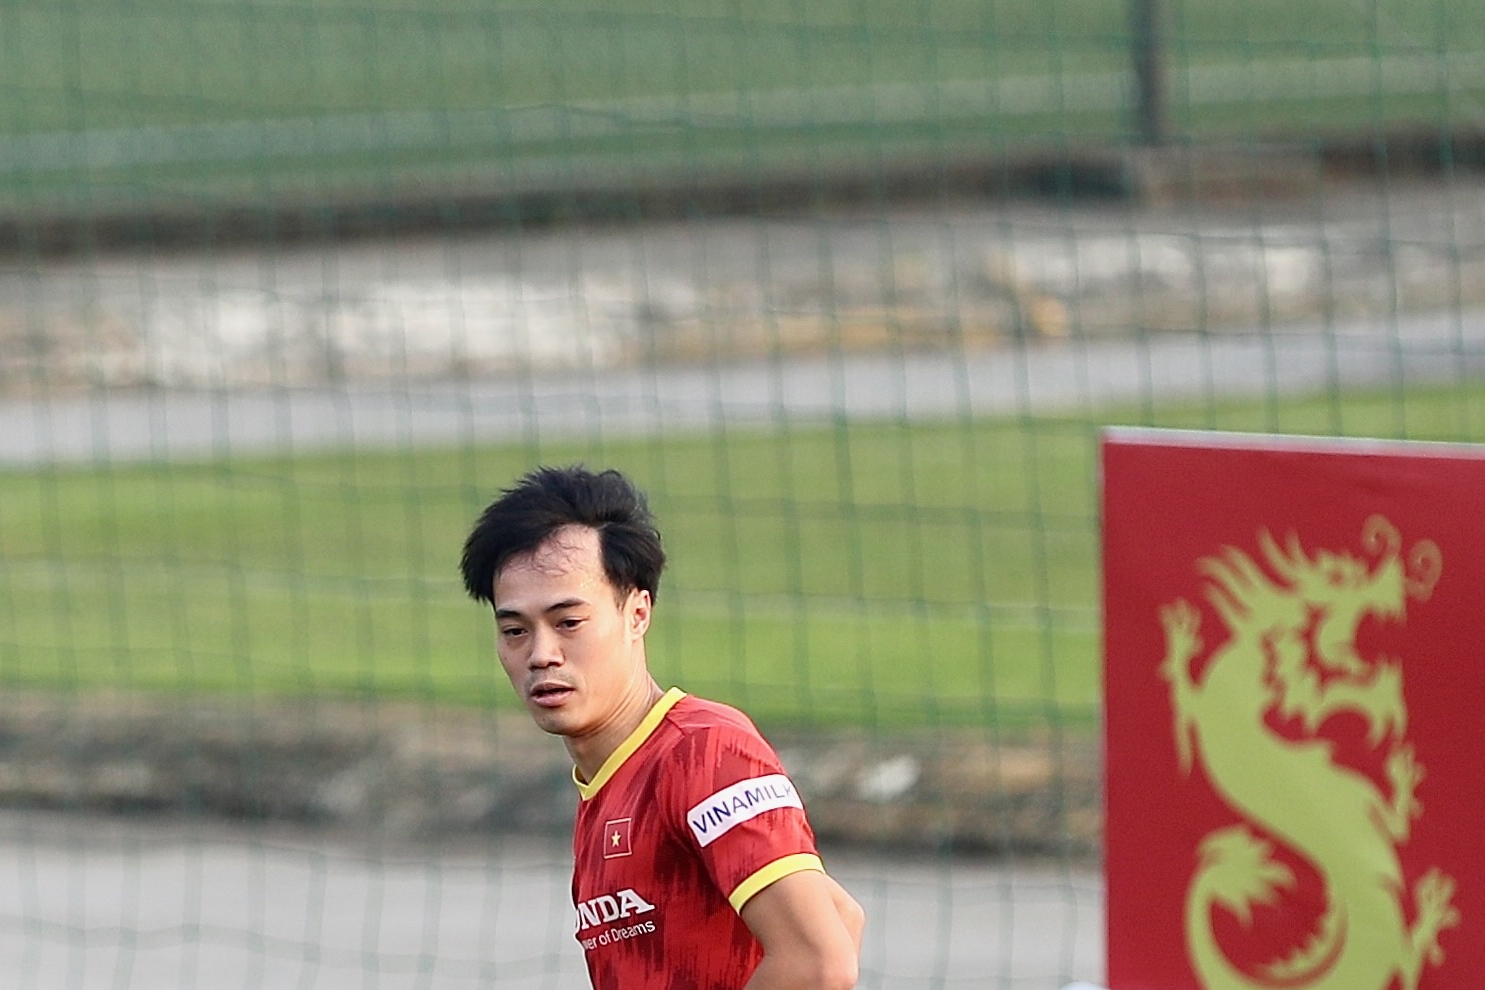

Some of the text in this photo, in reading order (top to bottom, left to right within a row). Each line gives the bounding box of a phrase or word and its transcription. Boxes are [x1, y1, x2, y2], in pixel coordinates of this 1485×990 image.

[692, 784, 791, 834] VINAMILK
[575, 888, 656, 930] NDA
[598, 930, 611, 946] of
[610, 920, 656, 942] Dreams
